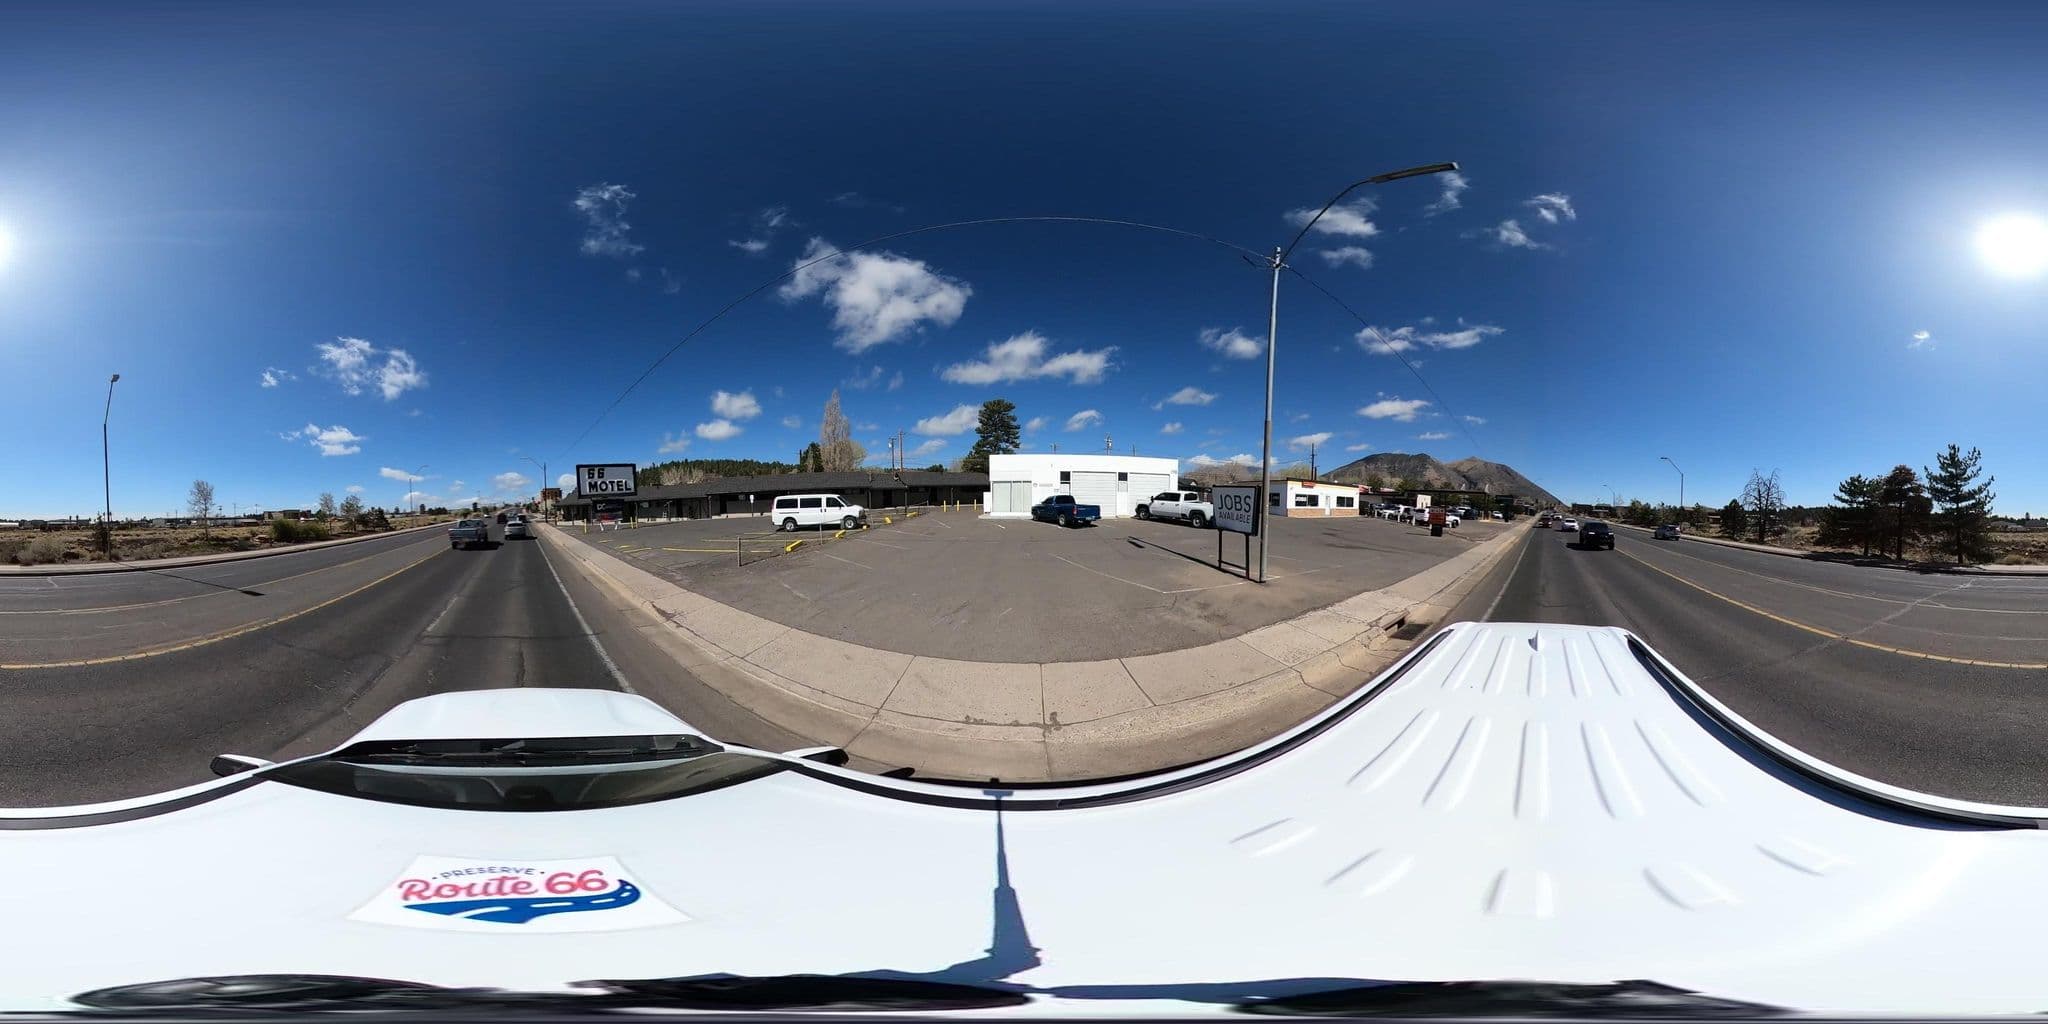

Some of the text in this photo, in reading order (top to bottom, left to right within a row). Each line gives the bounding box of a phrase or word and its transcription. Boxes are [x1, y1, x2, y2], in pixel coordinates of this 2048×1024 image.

[588, 468, 605, 479] 66
[588, 480, 631, 492] MOTEL
[1218, 494, 1251, 513] JOBS
[1218, 511, 1251, 524] AVAILABLE
[440, 866, 536, 880] PRESERVE
[397, 869, 609, 901] Route 66
